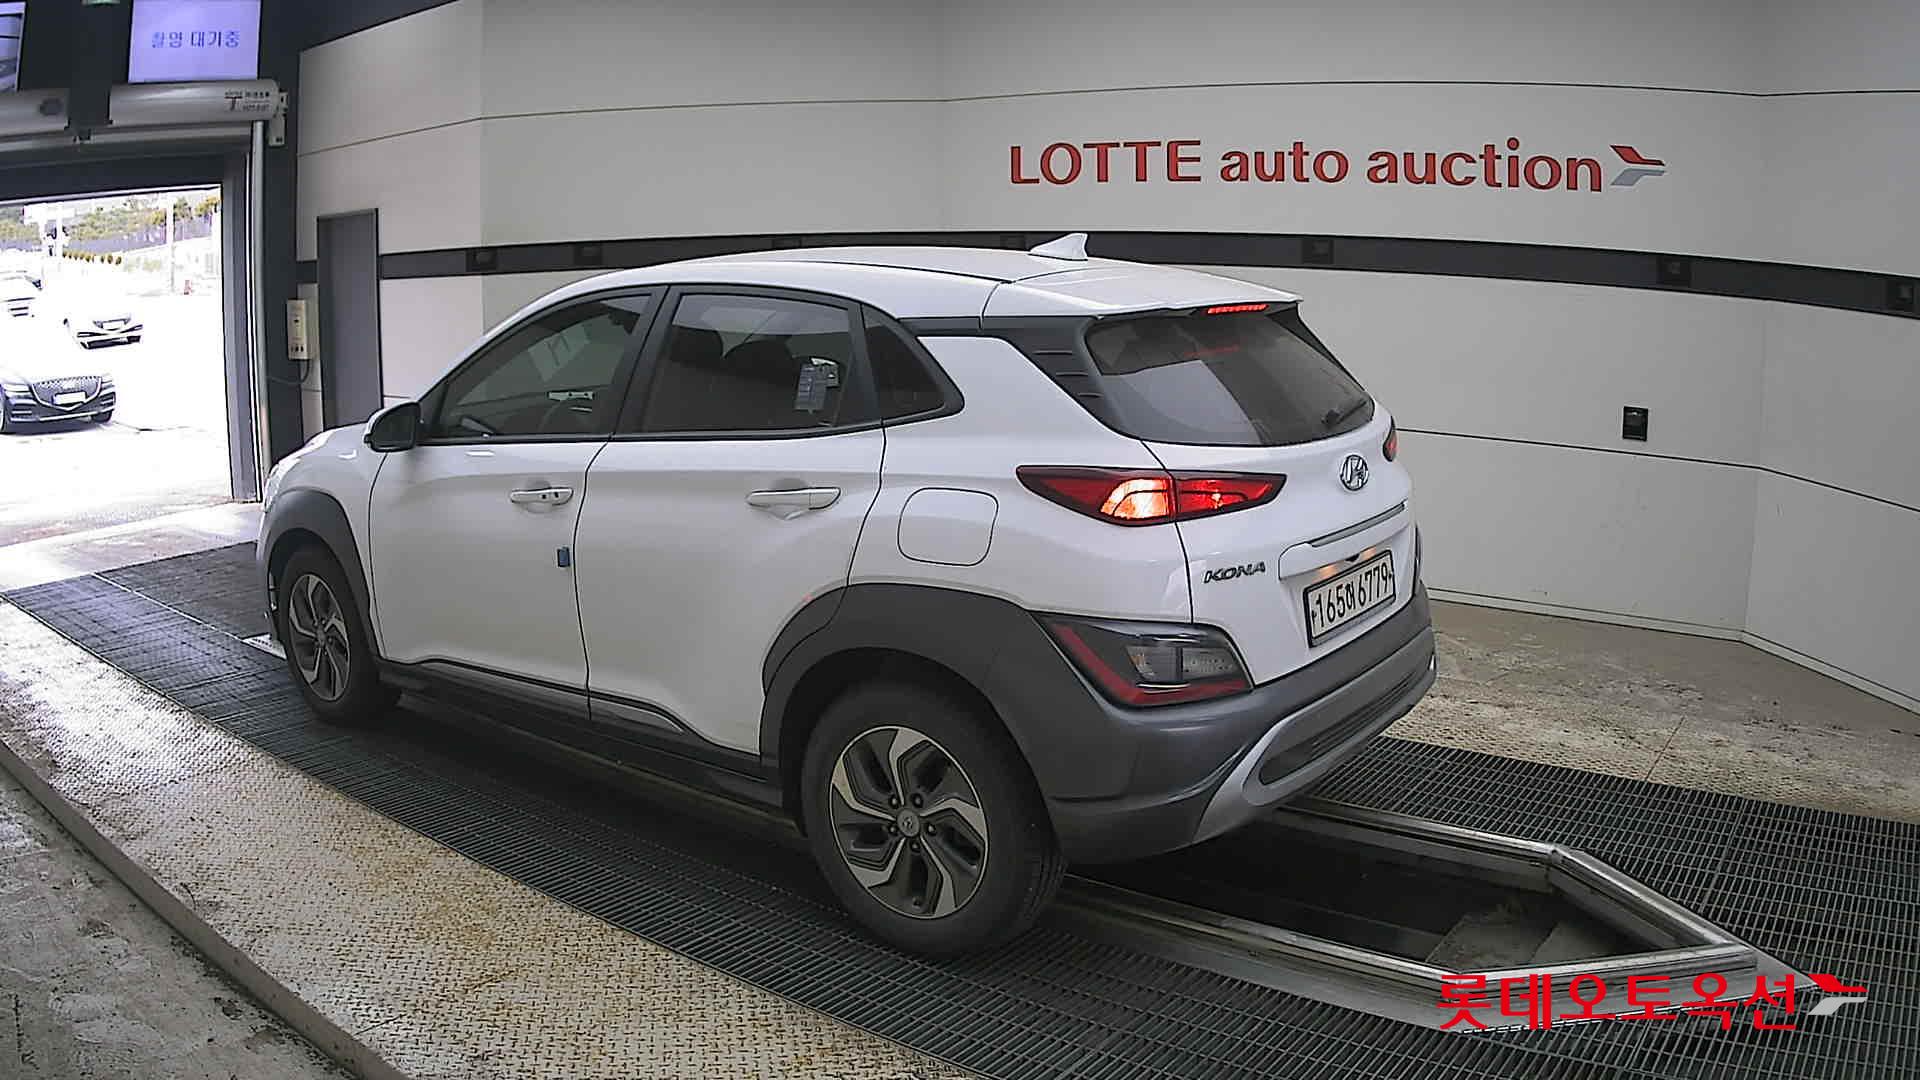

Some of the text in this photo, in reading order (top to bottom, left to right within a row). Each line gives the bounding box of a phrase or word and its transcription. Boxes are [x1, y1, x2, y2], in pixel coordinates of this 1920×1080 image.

[190, 31, 240, 48] 대기중
[1010, 137, 1602, 191] LOTTE auto auction
[1203, 561, 1266, 583] KONA
